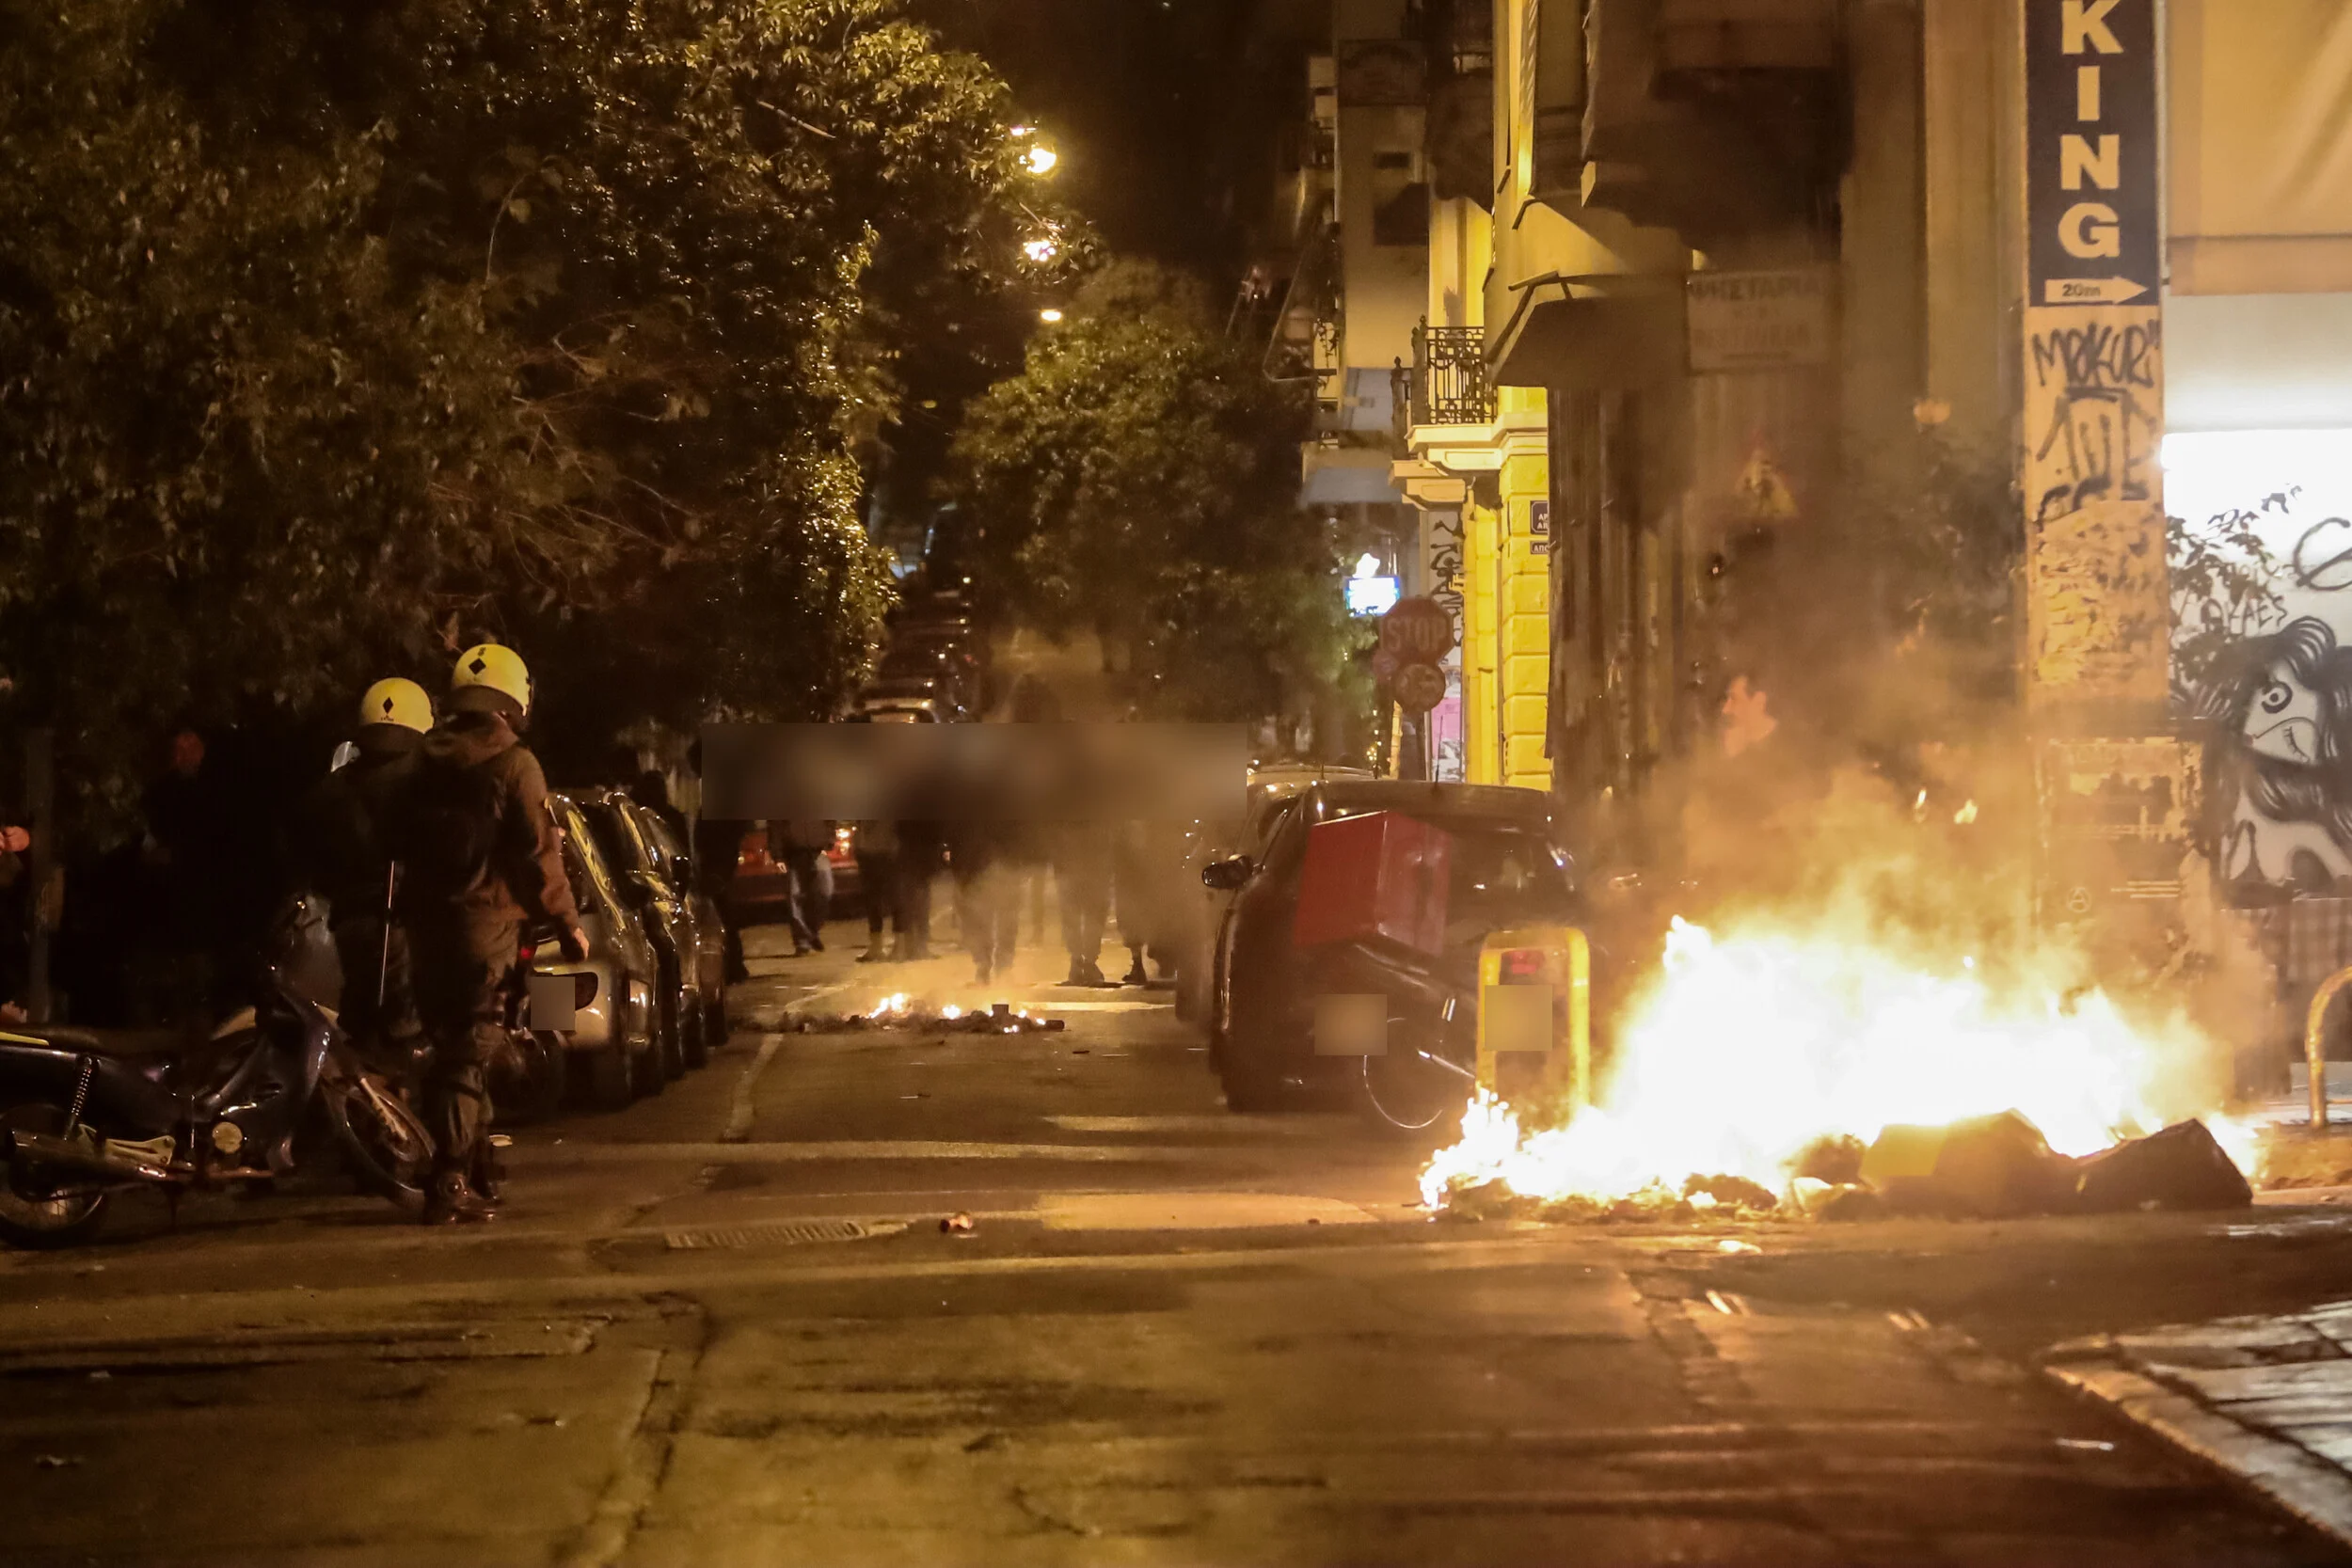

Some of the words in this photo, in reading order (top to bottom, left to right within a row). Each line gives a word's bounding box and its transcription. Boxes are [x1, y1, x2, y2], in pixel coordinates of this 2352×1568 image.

[2058, 0, 2123, 258] KING
[2062, 284, 2101, 297] 20m
[1387, 616, 1448, 653] STOP
